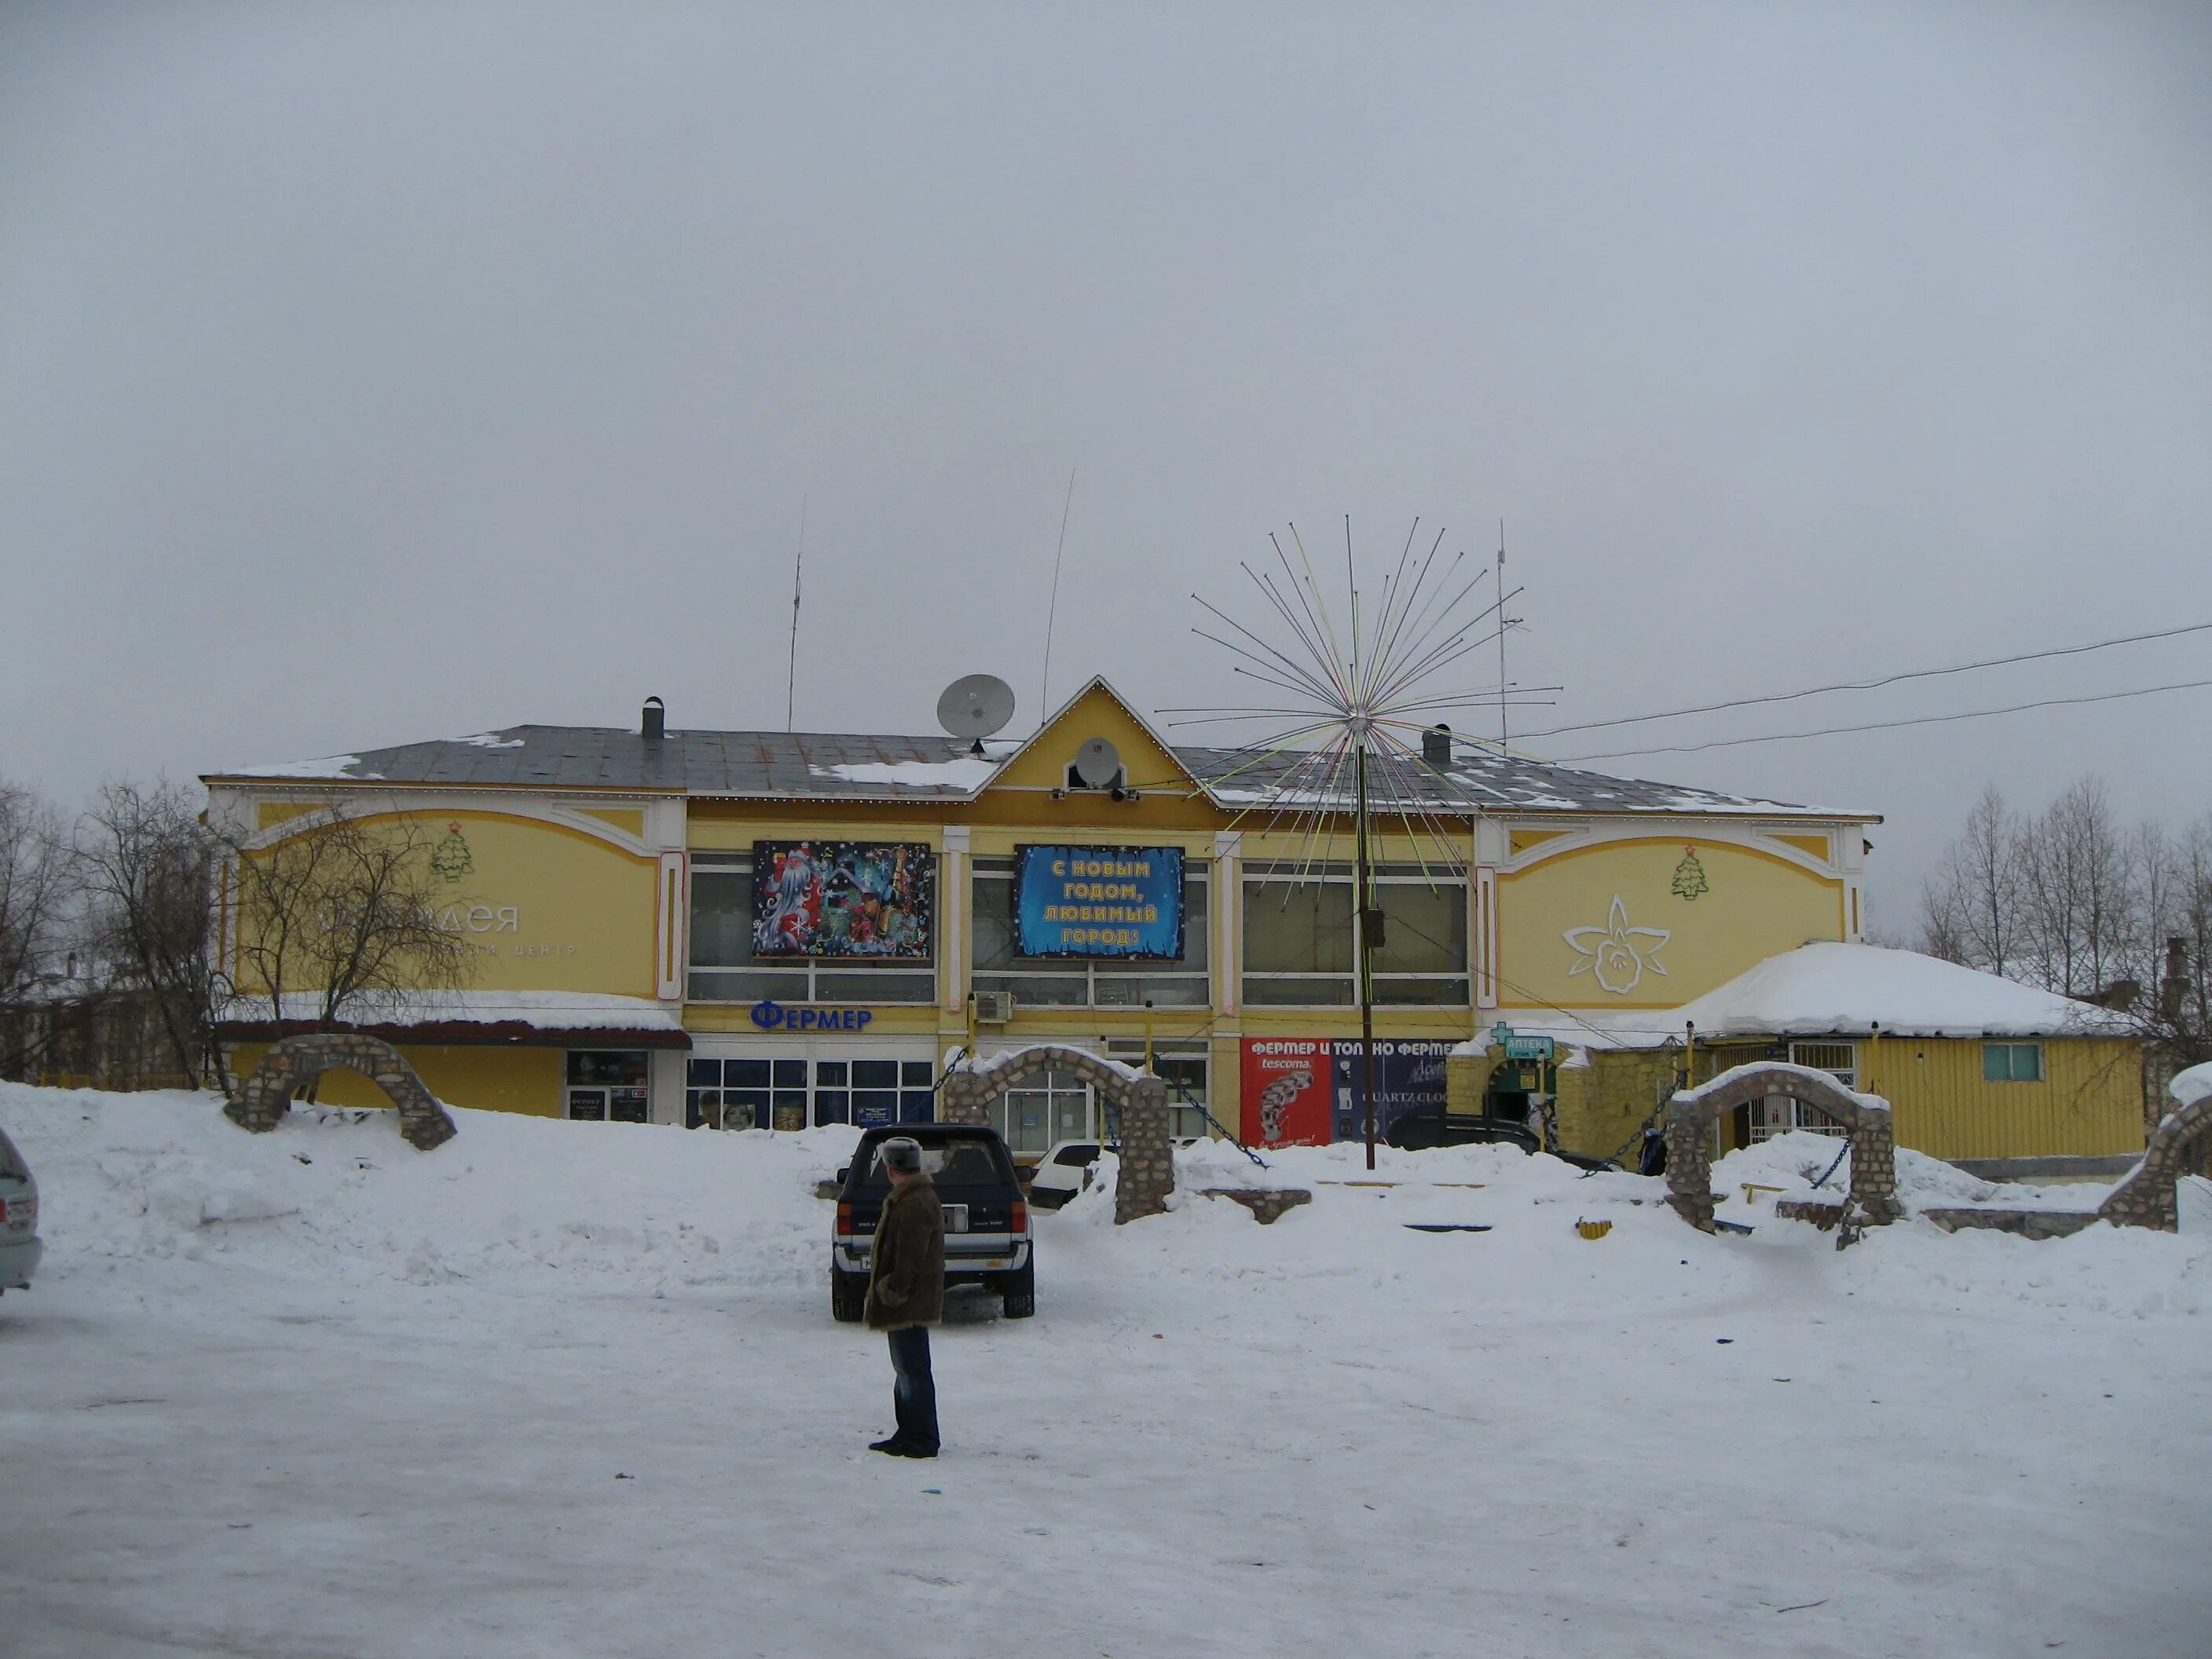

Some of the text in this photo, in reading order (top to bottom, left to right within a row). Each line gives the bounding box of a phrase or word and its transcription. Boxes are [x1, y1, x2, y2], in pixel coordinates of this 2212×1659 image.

[1051, 859, 1150, 878] С НОВЫМ
[1063, 883, 1144, 903] ГОДОМ,
[1042, 904, 1158, 923] ЛЮБИМЫЙ
[1062, 928, 1138, 946] ГОРОД!
[750, 1000, 872, 1029] ФЕРМЕР
[1251, 1042, 1317, 1056] ФЕРМЕР
[1333, 1042, 1395, 1056] ТОЛКО
[1397, 1042, 1455, 1057] ФЕРМЕ
[1417, 1093, 1447, 1104] CLOC
